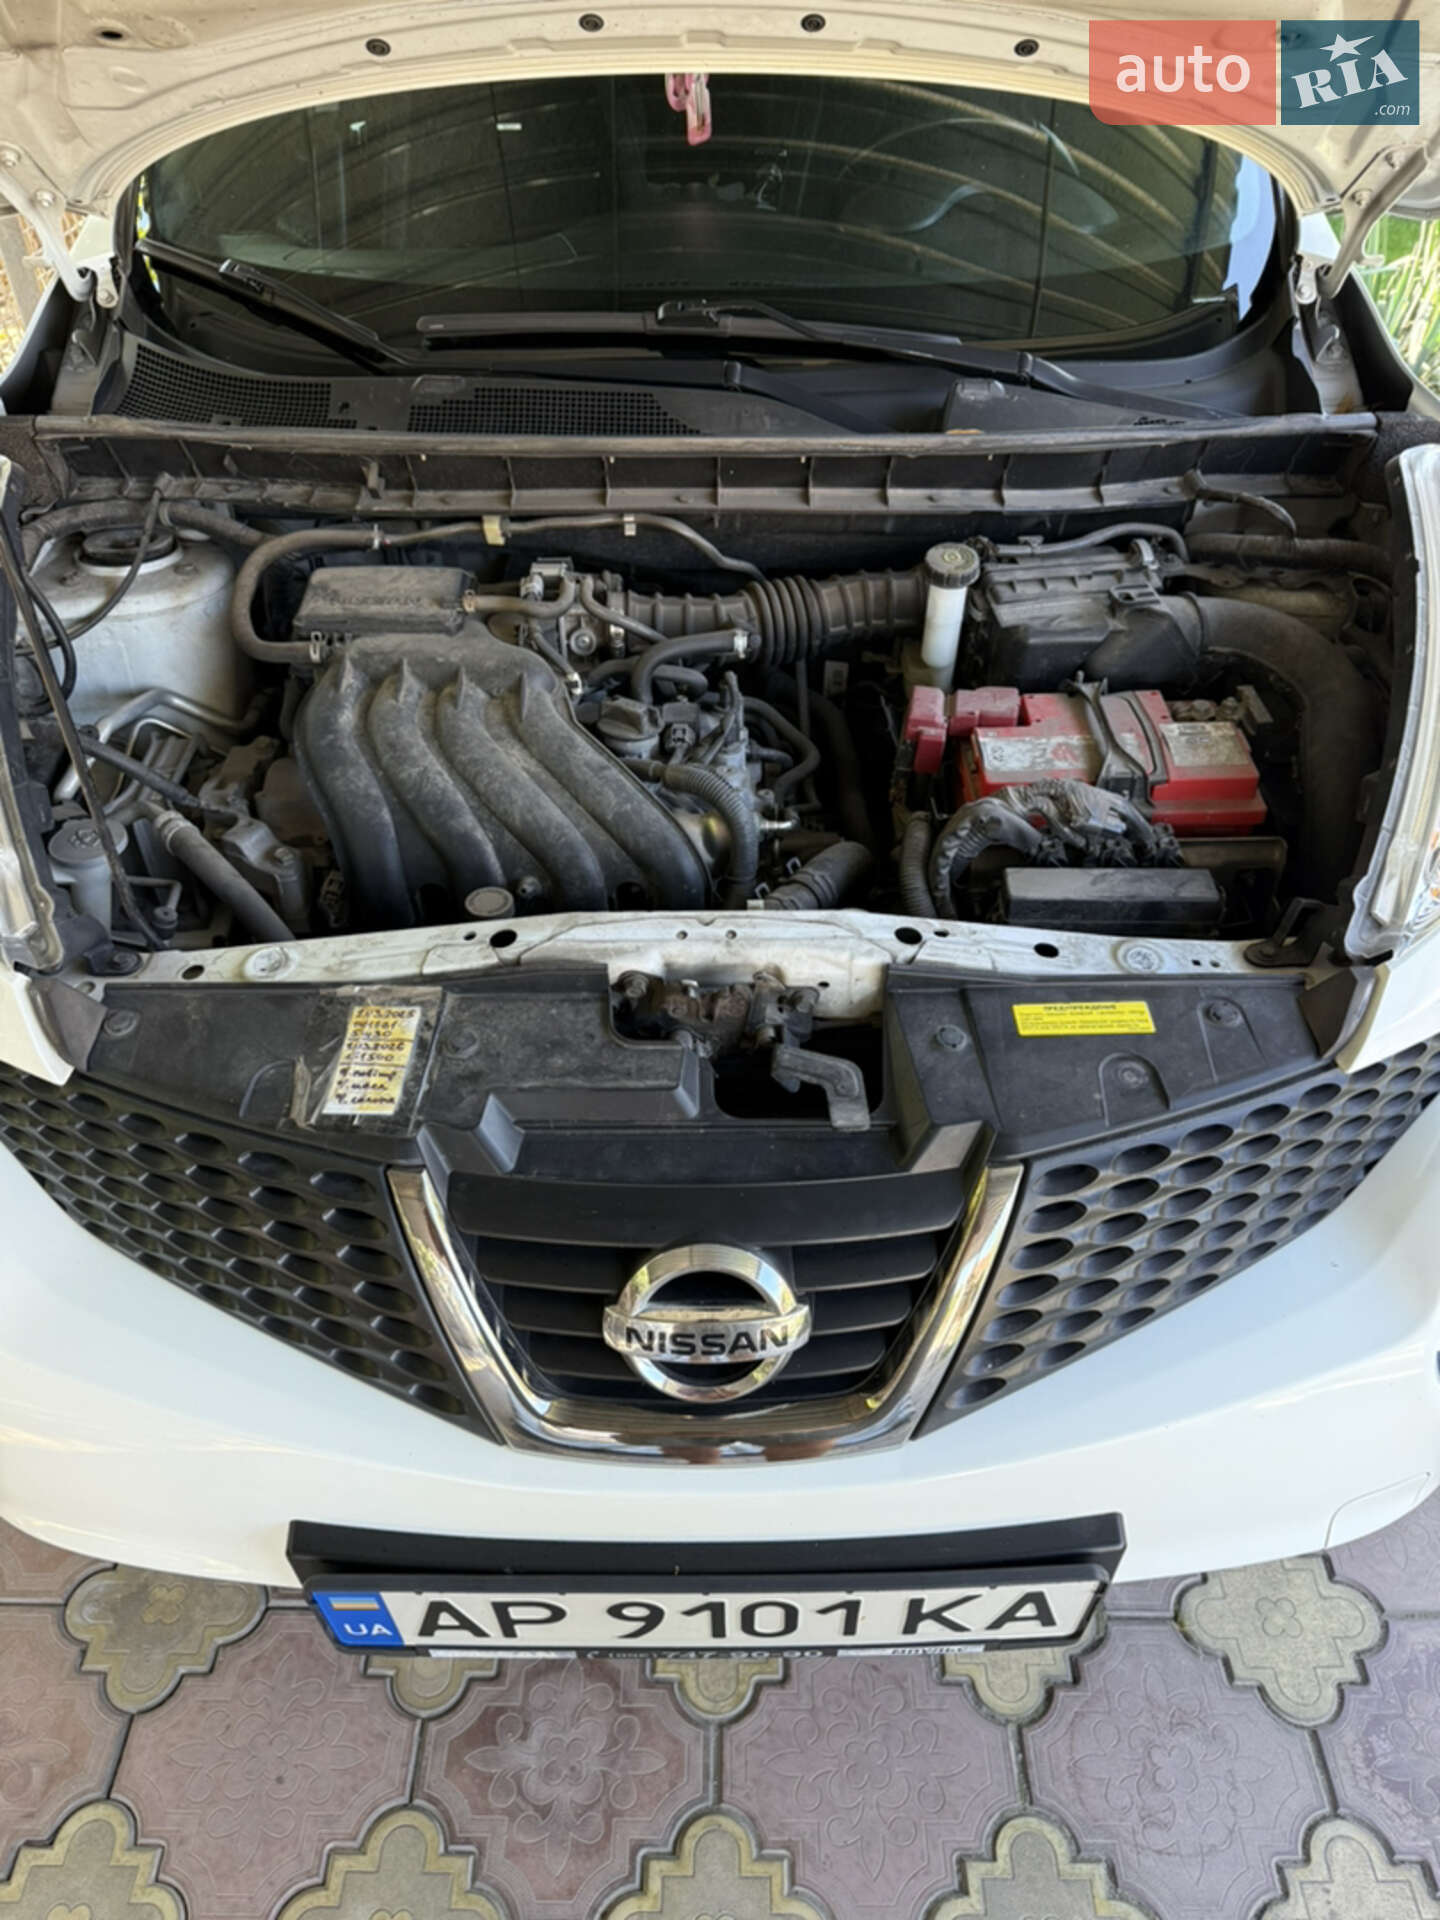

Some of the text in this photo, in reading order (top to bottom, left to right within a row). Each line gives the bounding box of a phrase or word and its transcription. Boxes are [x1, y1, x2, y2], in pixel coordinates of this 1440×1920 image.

[625, 1325, 789, 1356] NISSAN
[343, 1622, 393, 1636] UA
[417, 1590, 1058, 1639] AP 9101 KA
